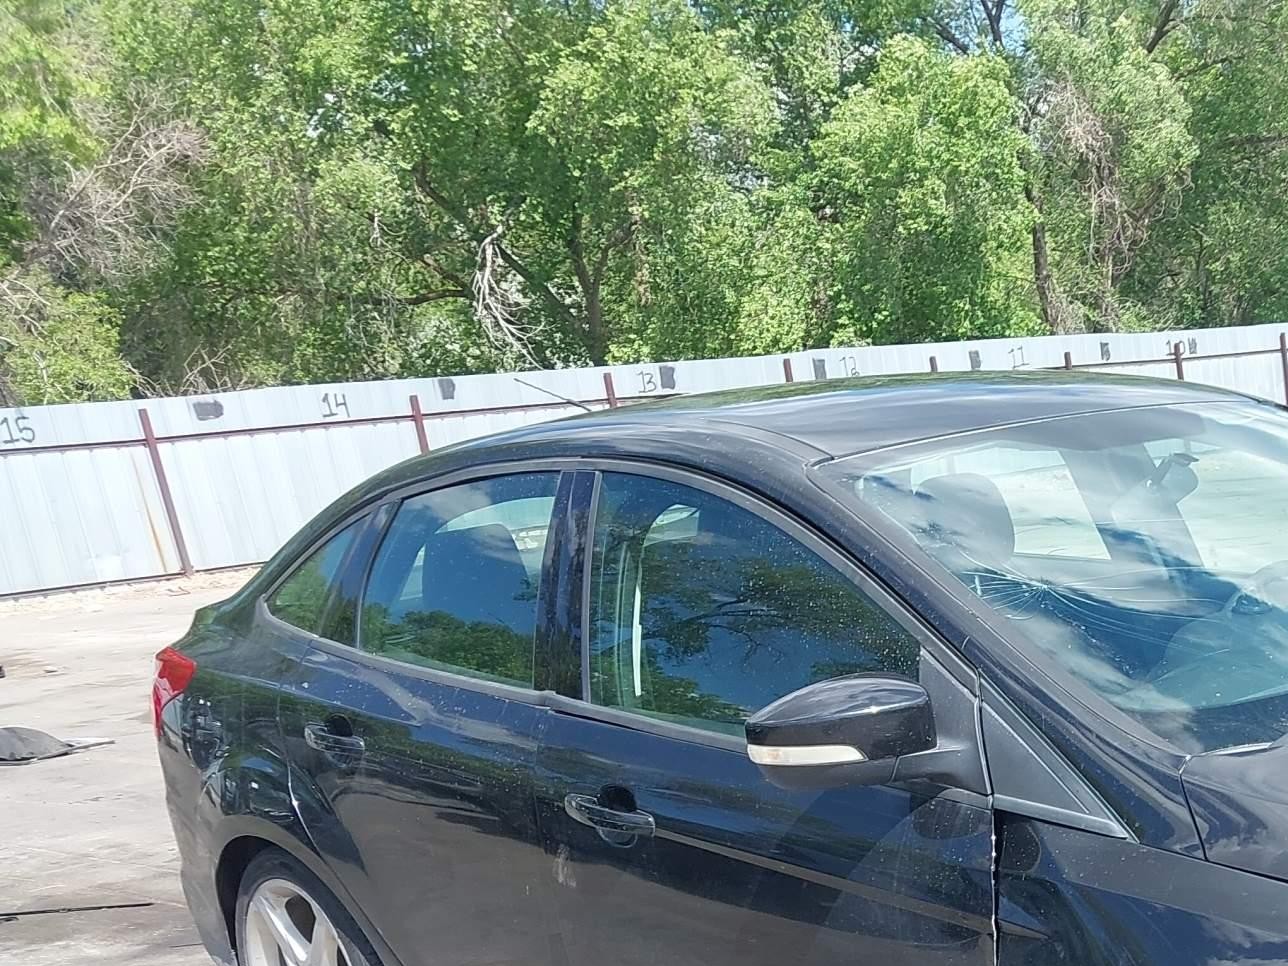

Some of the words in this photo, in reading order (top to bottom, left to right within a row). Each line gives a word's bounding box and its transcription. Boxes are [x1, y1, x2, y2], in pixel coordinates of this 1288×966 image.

[637, 371, 657, 393] 13
[322, 393, 350, 418] 14
[1, 416, 35, 444] 15
